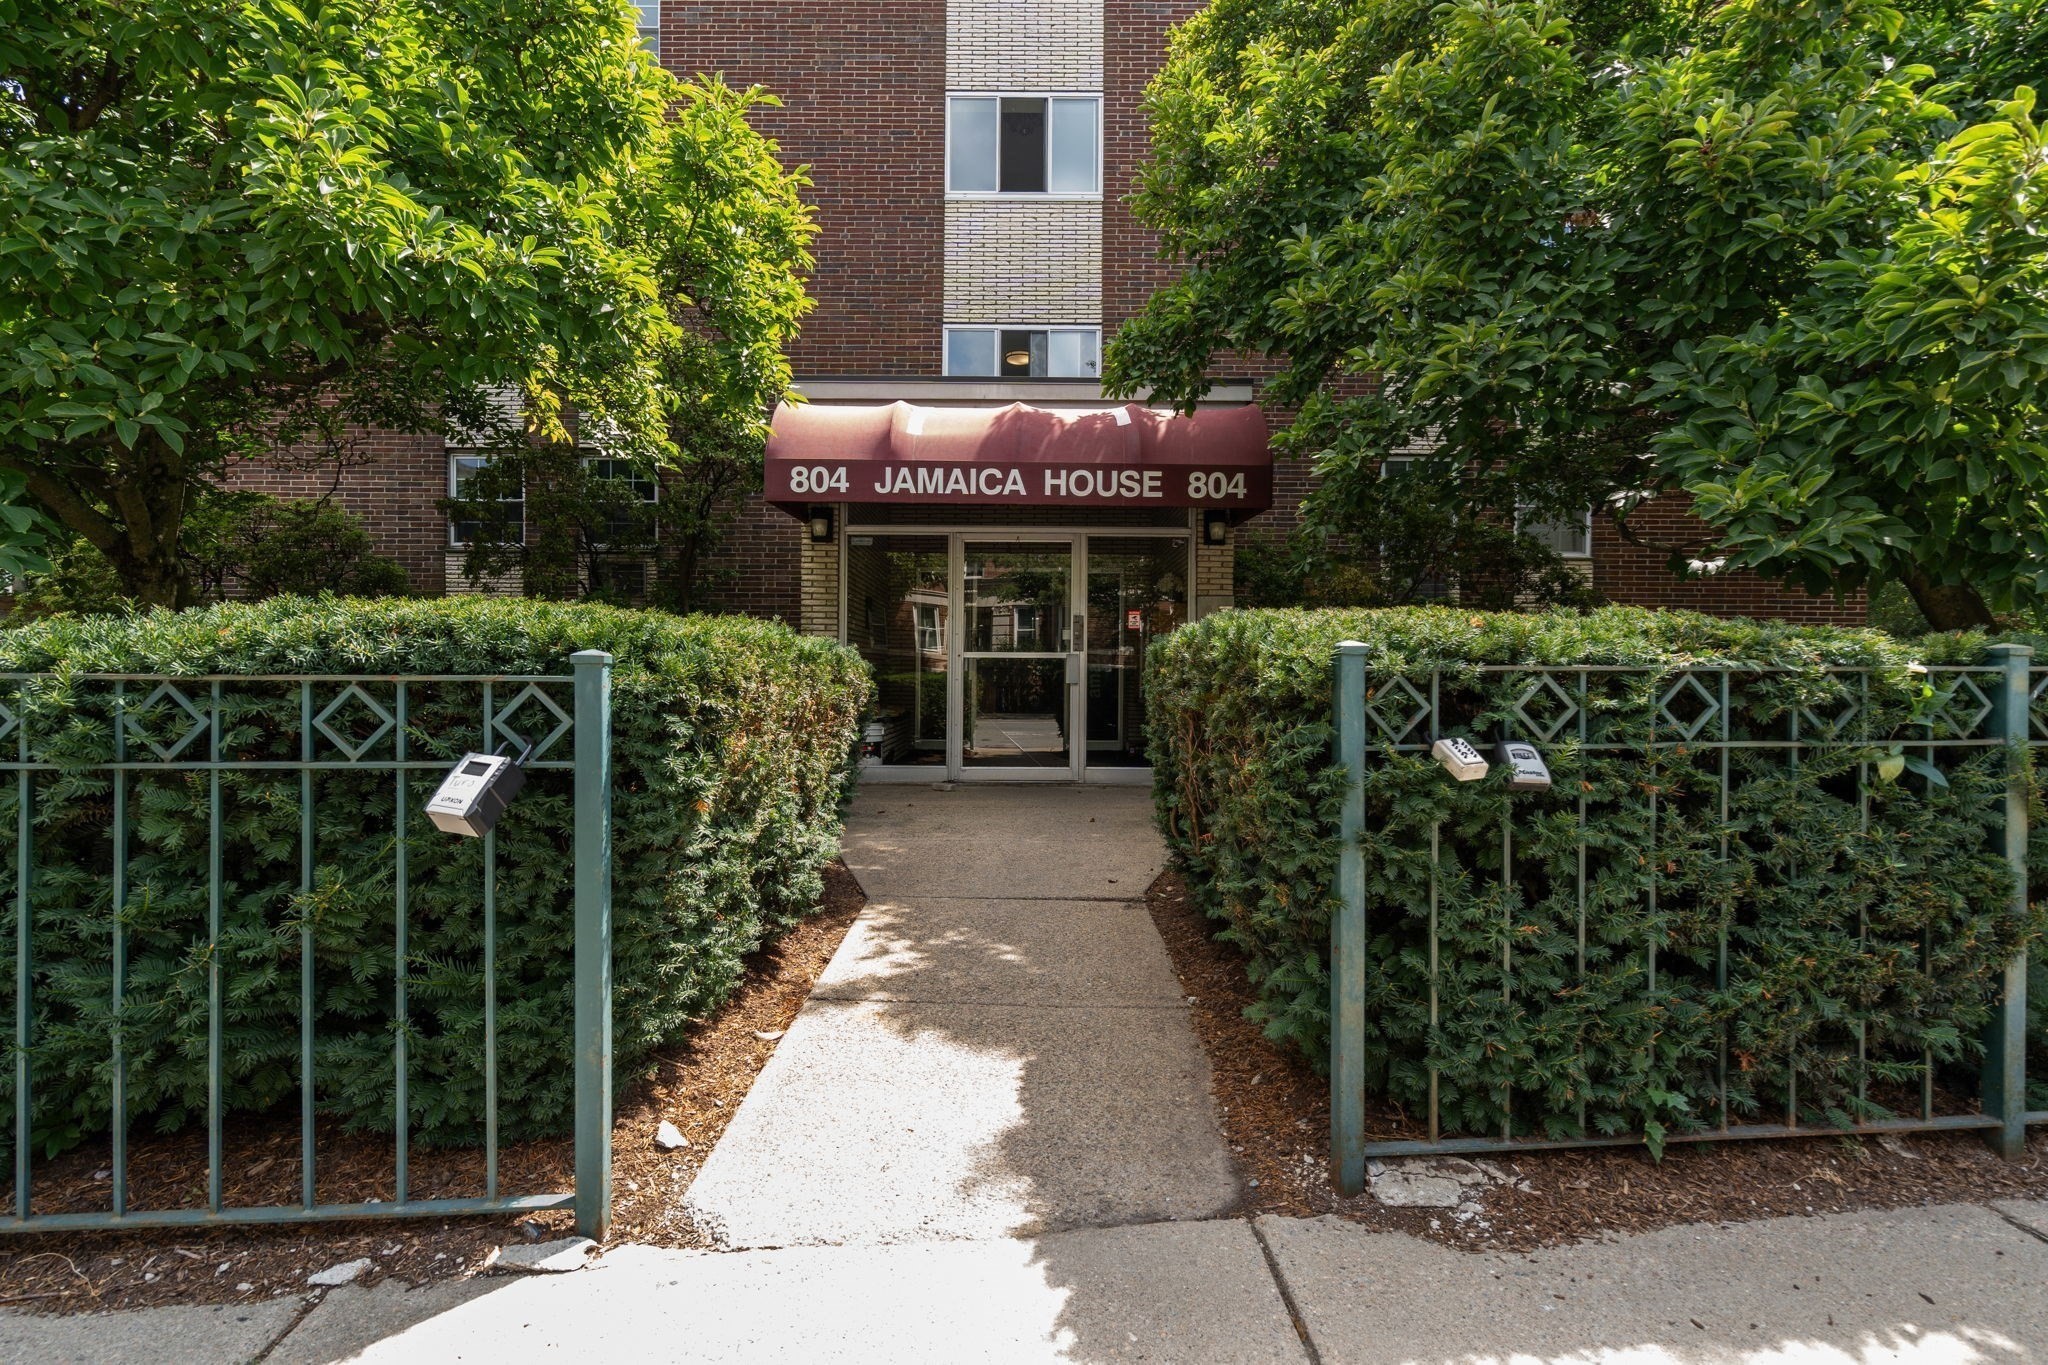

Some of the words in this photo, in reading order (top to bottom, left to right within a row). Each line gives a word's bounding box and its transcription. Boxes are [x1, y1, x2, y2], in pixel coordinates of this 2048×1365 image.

[790, 466, 850, 493] 804
[874, 466, 1027, 495] JAMAICA
[1044, 469, 1163, 498] HOUSE
[1187, 471, 1248, 499] 804
